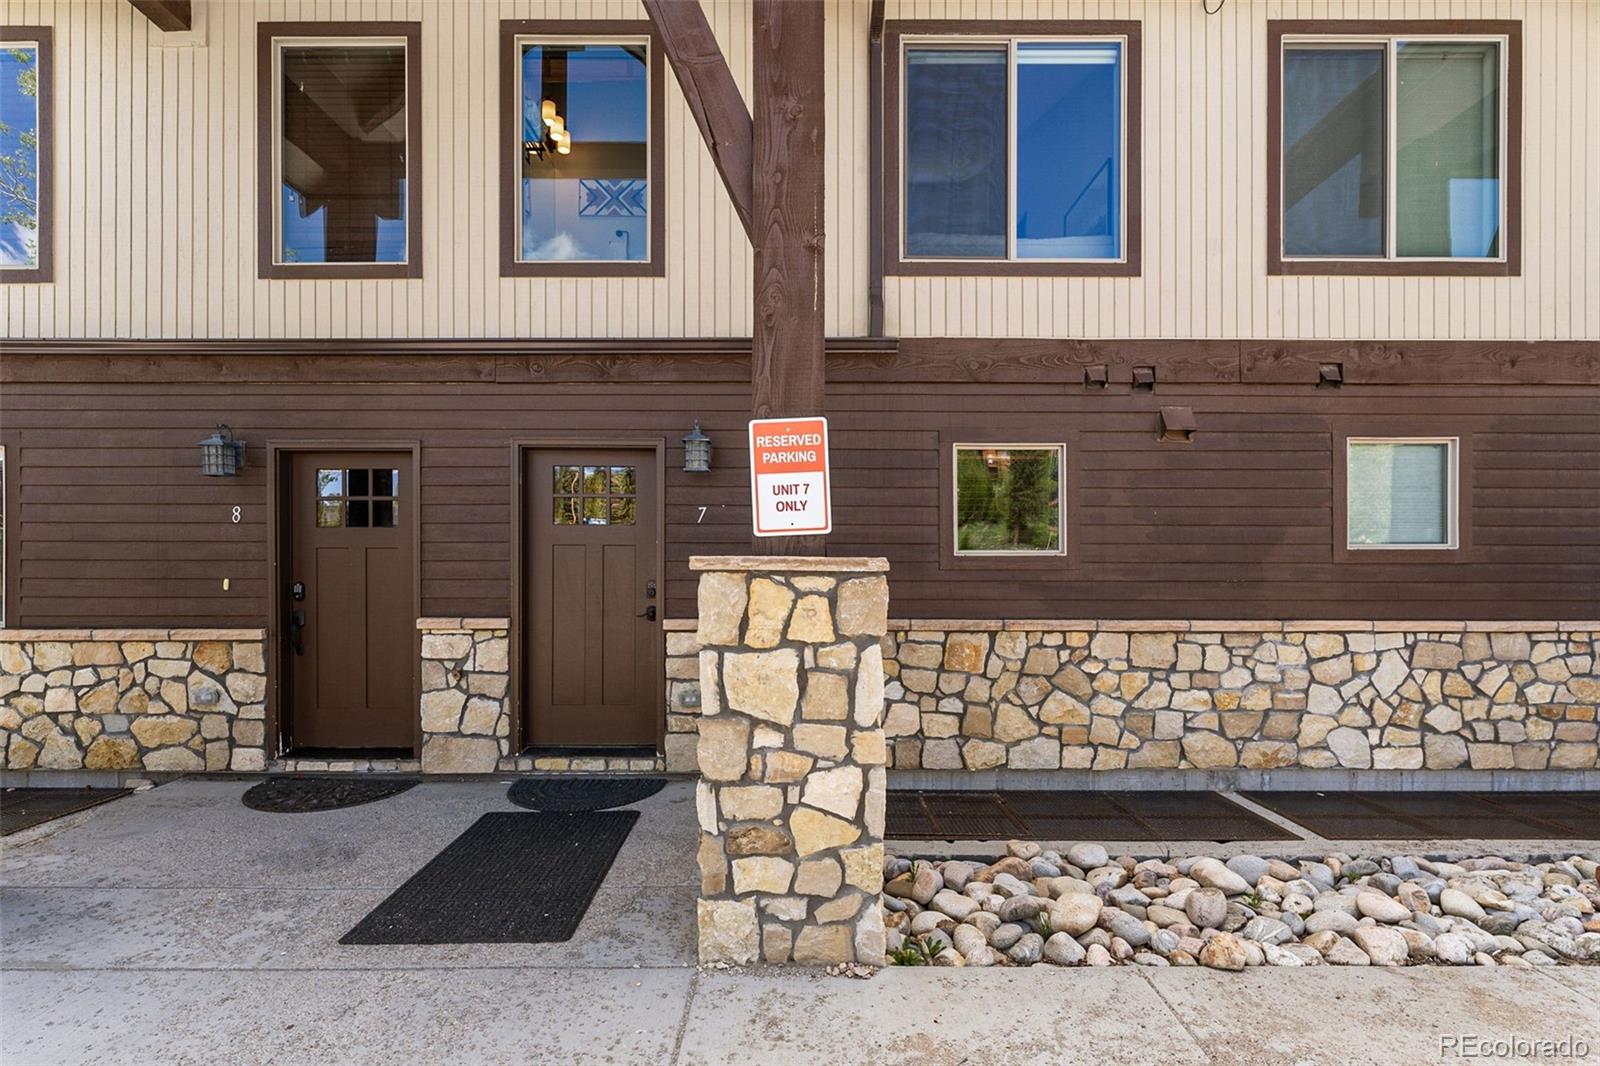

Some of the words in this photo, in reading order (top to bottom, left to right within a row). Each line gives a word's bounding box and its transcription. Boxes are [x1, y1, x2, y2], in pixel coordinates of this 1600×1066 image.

[756, 433, 821, 448] RESERVED
[762, 451, 817, 464] PARKING
[772, 484, 800, 496] UNIT
[803, 483, 810, 495] 7
[776, 500, 808, 512] ONLY
[232, 505, 241, 523] 8
[697, 506, 707, 523] 7
